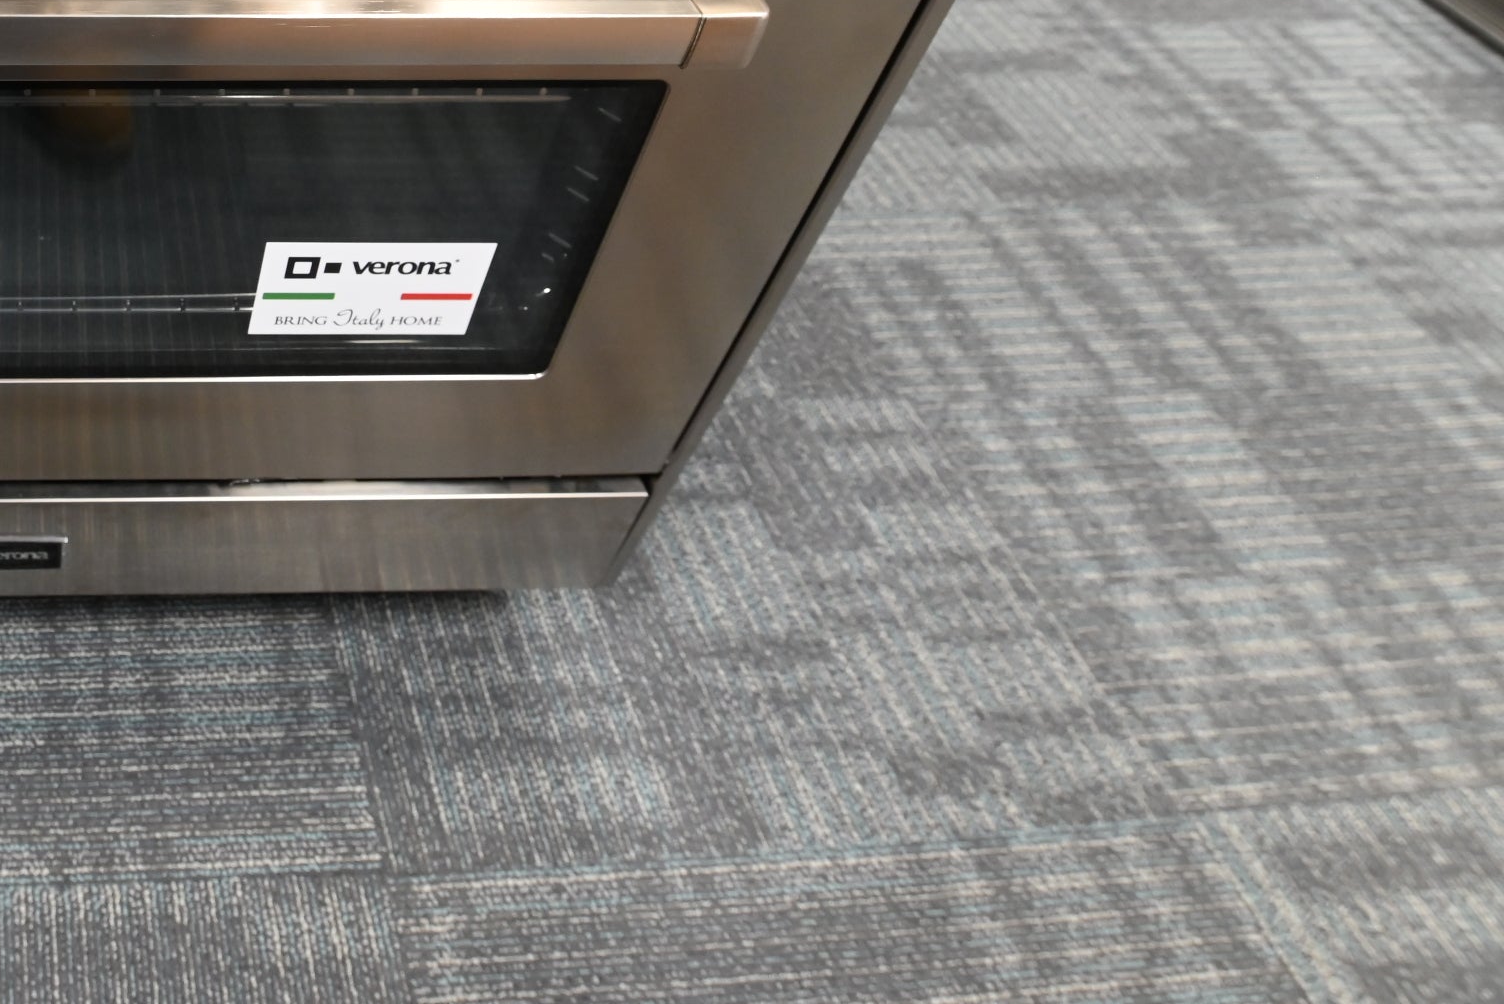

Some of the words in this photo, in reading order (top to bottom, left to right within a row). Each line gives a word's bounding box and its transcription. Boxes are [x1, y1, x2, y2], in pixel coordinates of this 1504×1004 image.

[352, 260, 452, 275] verona
[274, 315, 328, 326] BRING
[332, 308, 385, 330] Italy
[390, 315, 443, 326] HOME
